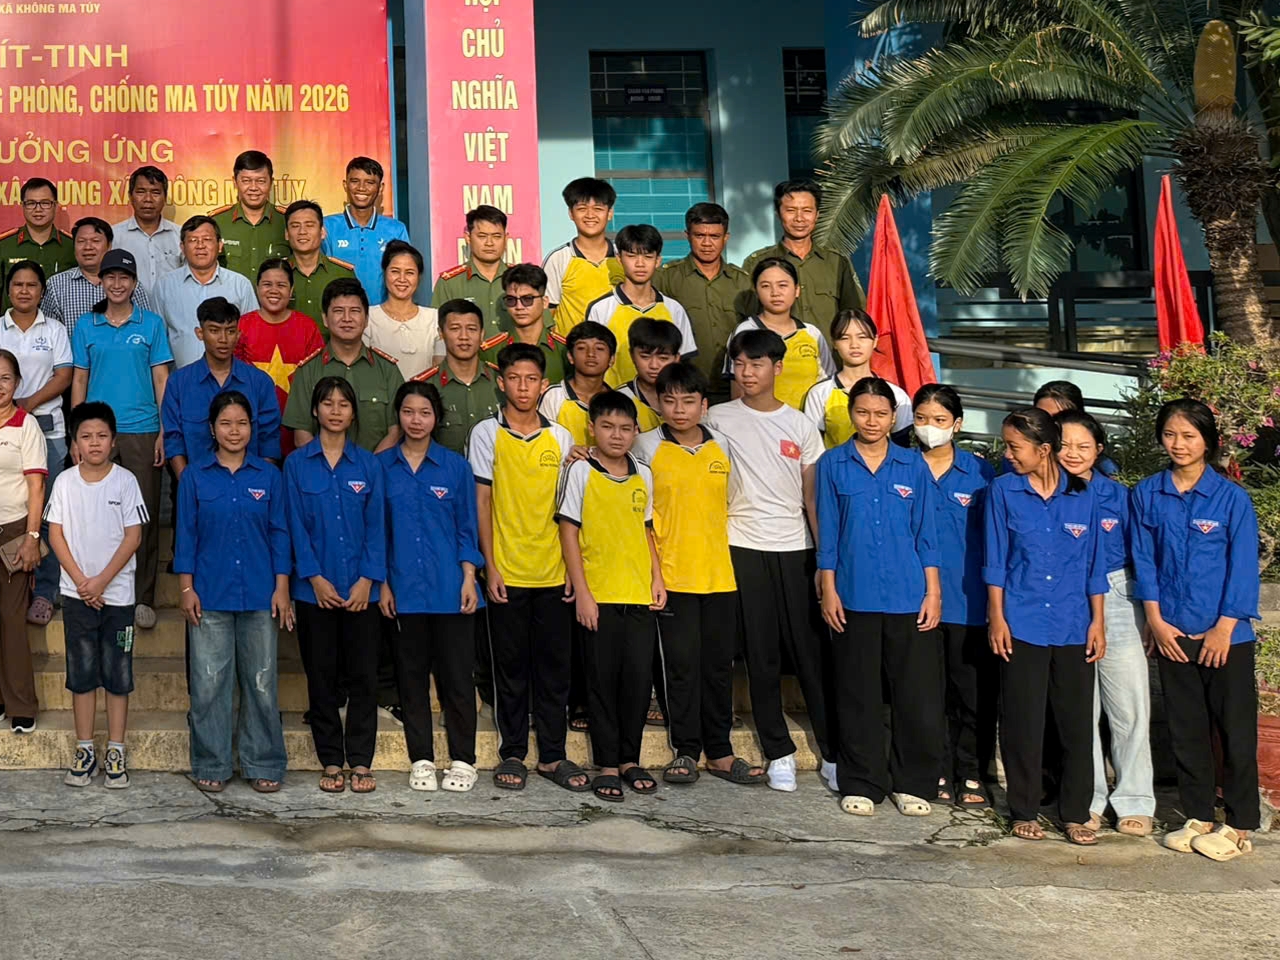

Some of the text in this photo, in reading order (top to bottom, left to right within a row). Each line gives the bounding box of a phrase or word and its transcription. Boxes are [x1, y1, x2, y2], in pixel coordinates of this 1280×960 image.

[16, 1, 55, 15] KHÔNG
[58, 3, 76, 14] MA
[79, 0, 101, 14] TÚY
[461, 17, 505, 58] CHỦ
[9, 79, 83, 117] PHÒNG,
[90, 75, 158, 113] CHỐNG
[165, 85, 197, 113] MA
[203, 77, 240, 113] TÚY
[246, 78, 293, 112] NĂM
[299, 84, 349, 112] 2026
[451, 74, 519, 110] NGHĨA
[103, 134, 175, 163] ỨNG
[464, 126, 509, 169] VIỆT
[54, 178, 102, 211] ỰNG
[462, 184, 513, 215] NAM
